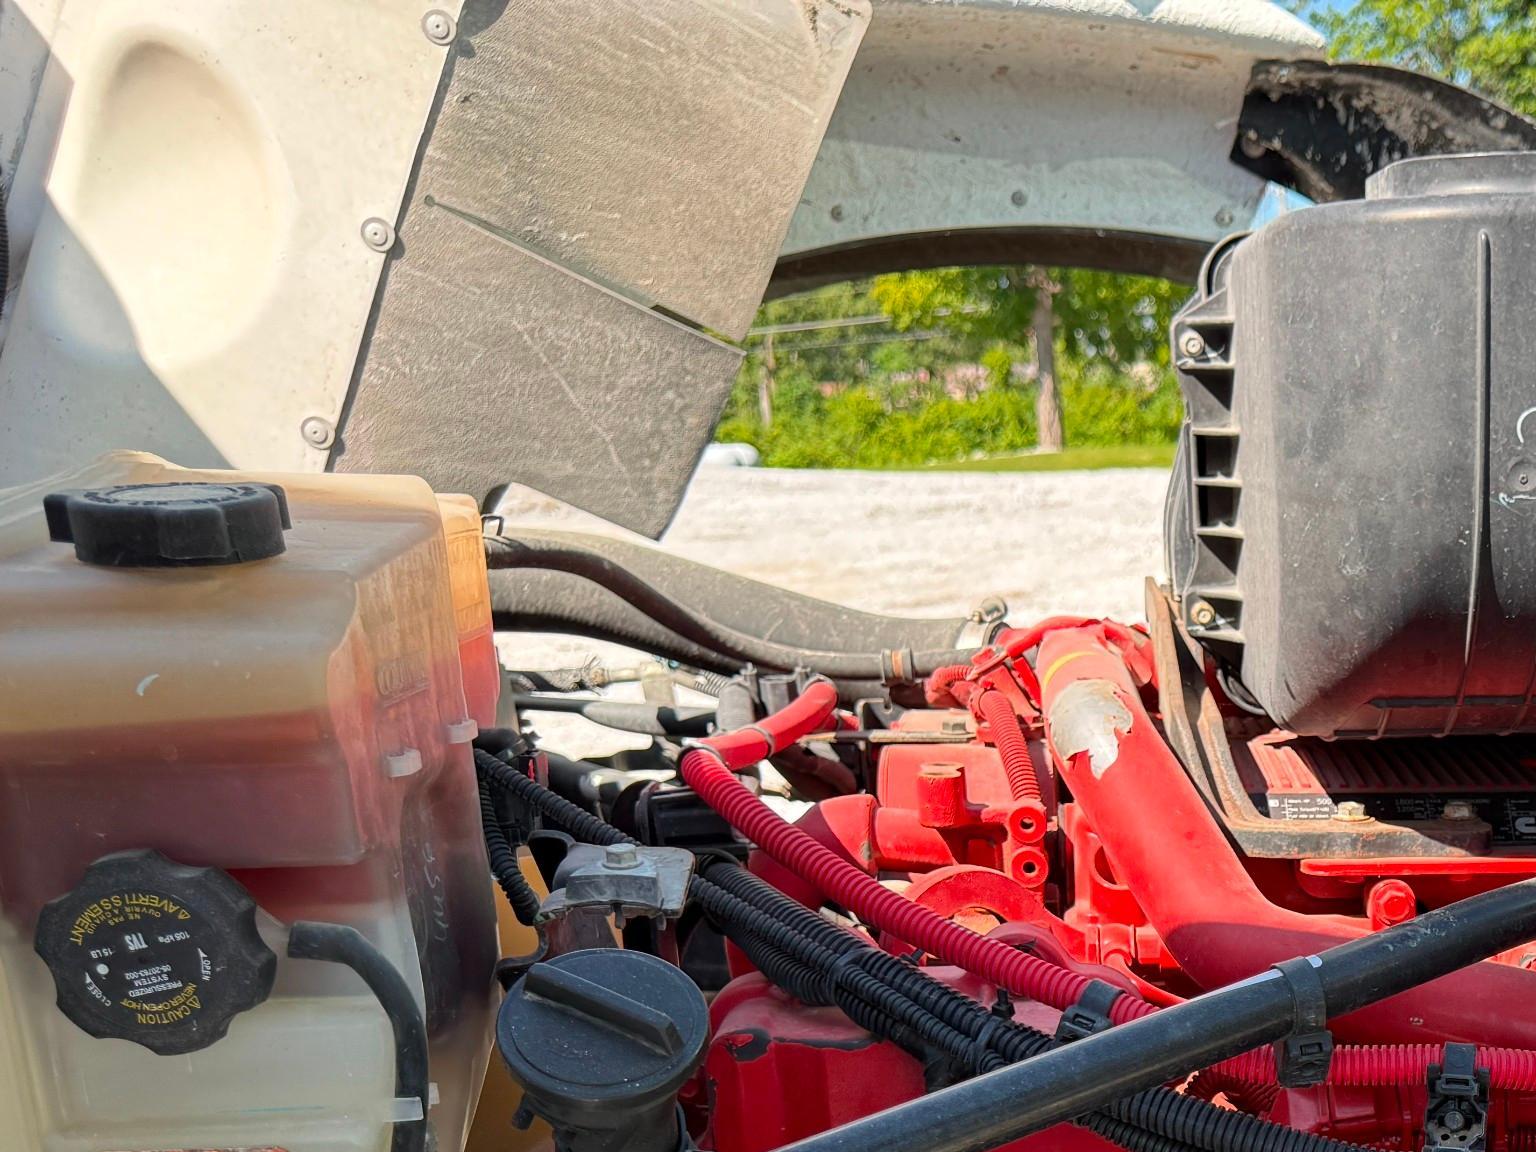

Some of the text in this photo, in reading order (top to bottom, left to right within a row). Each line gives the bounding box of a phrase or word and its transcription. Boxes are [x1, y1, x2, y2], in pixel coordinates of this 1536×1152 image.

[124, 932, 148, 951] TVS
[134, 973, 169, 986] SYSTEM
[201, 959, 211, 981] OPEN
[87, 981, 112, 1007] CLOSE
[120, 982, 198, 1011] NEVER OPEN HOT
[128, 980, 182, 998] PRESSURIZED
[137, 1005, 191, 1024] CAUTION
